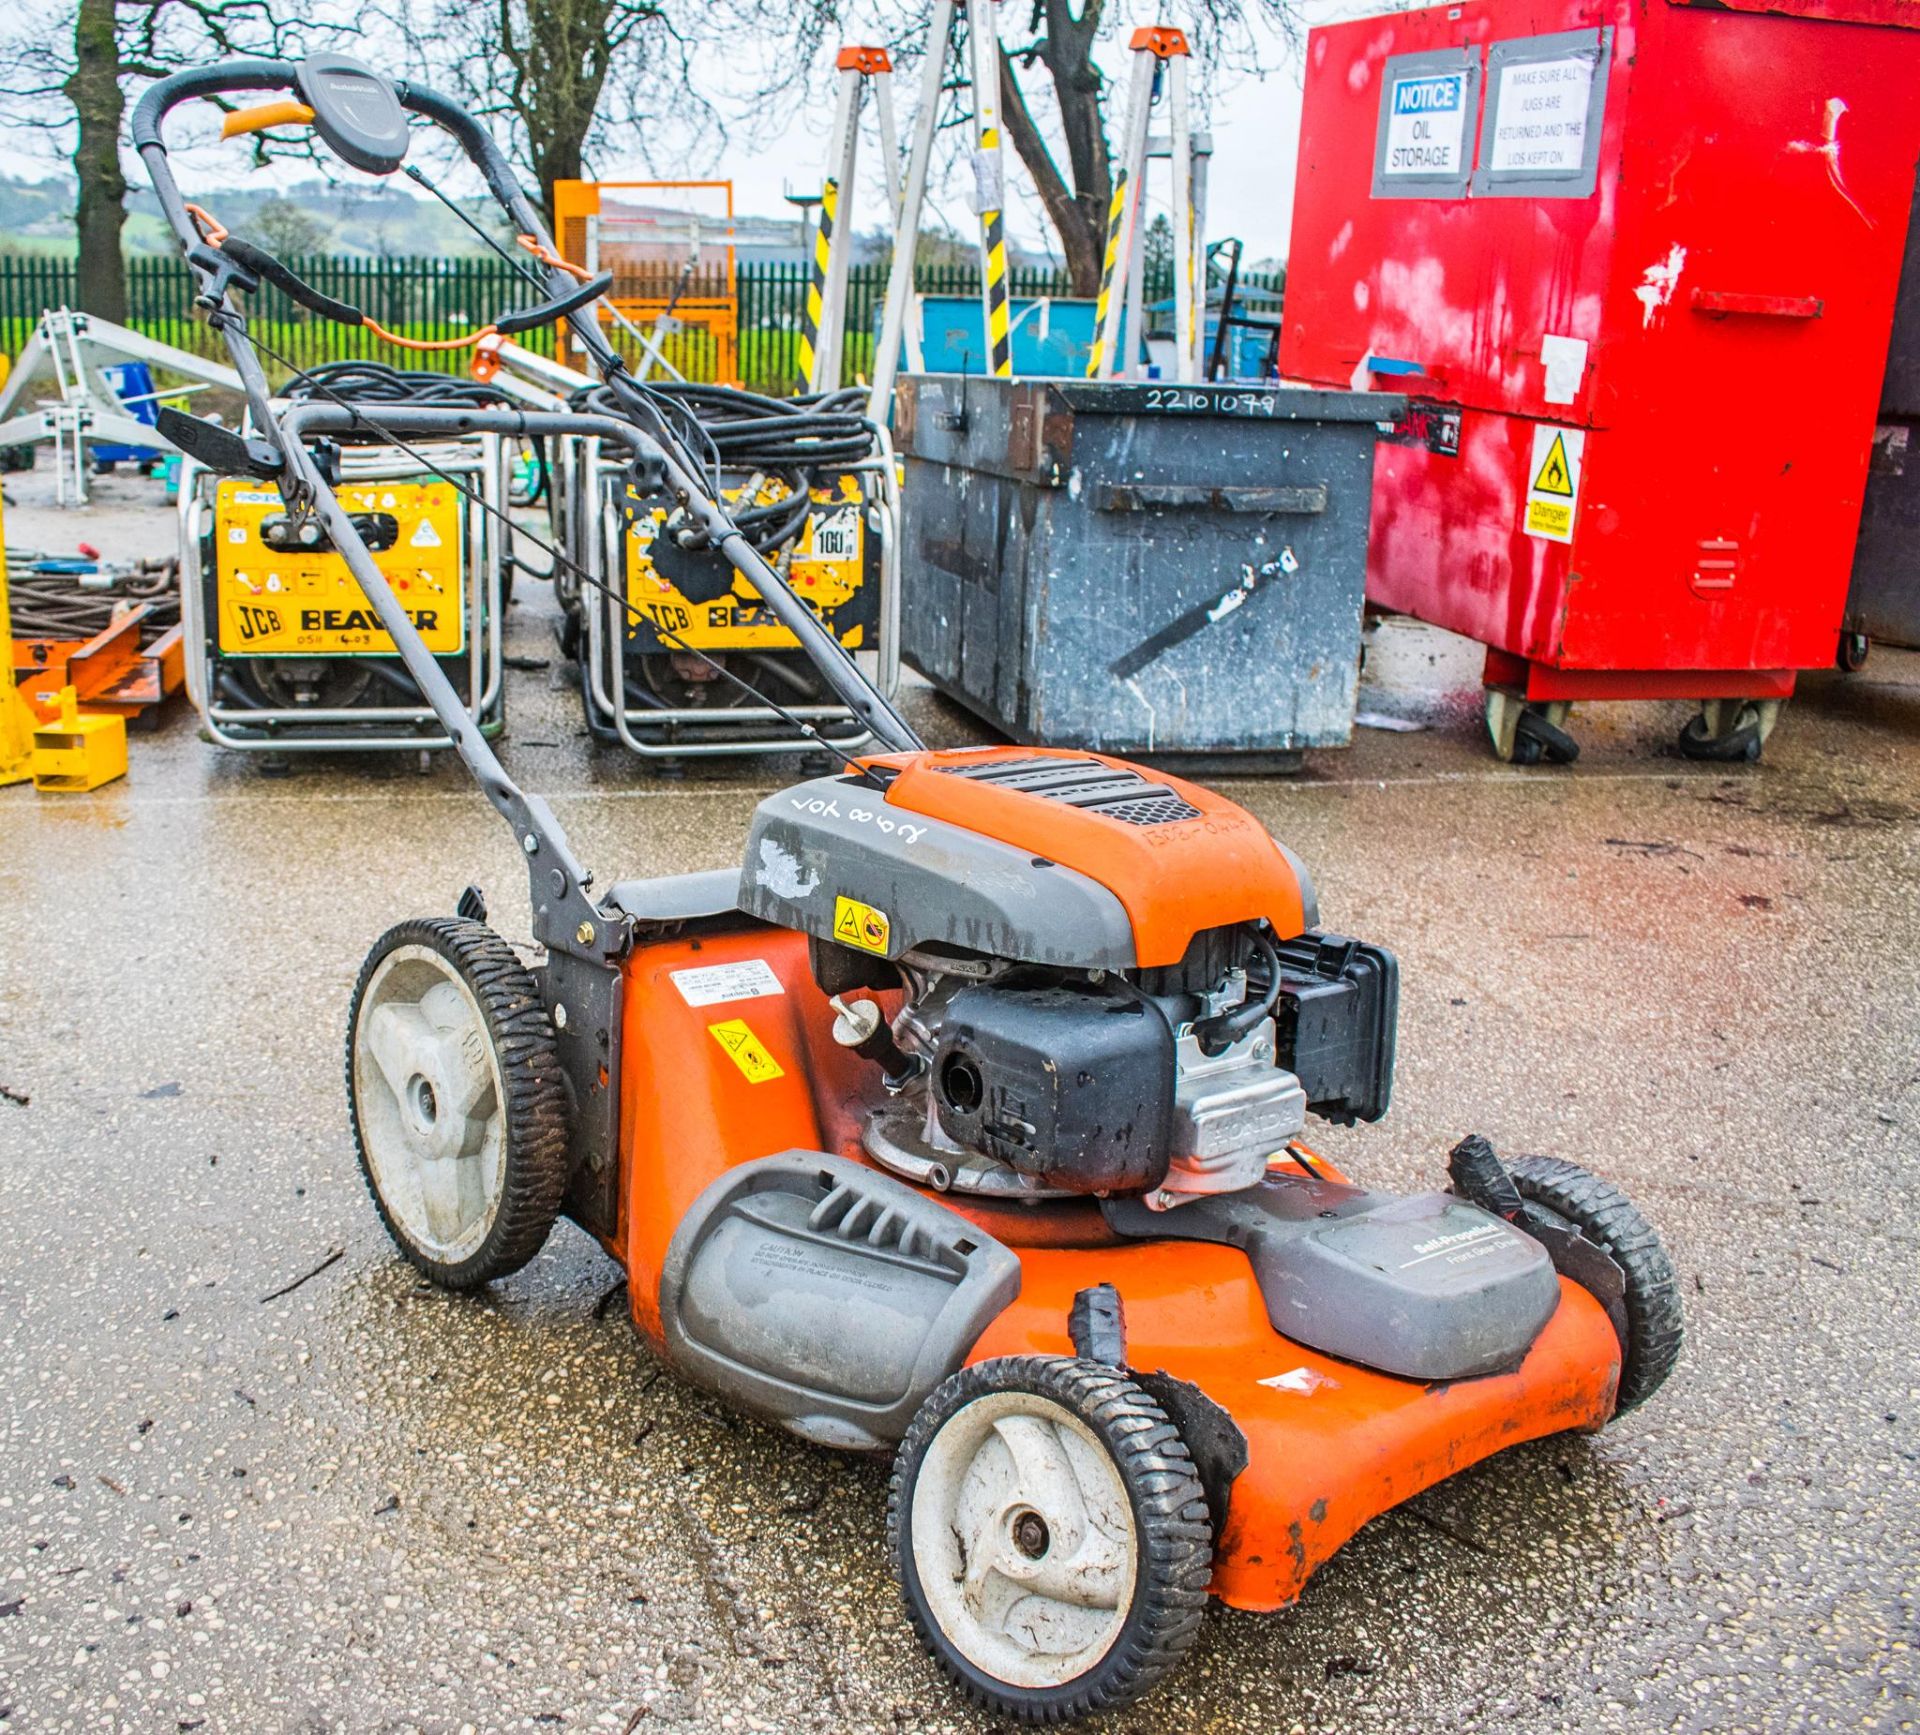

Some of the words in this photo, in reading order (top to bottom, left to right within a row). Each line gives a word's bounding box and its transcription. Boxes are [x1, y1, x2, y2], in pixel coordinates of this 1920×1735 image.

[1512, 71, 1538, 85] MAKE
[1539, 68, 1561, 84] SURE
[1562, 67, 1578, 80] ALL
[1399, 82, 1455, 109] NOTICE
[1521, 97, 1543, 112] JUGS
[1545, 95, 1562, 109] ARE
[1412, 120, 1432, 139] OIL
[1498, 125, 1542, 140] RETURNED
[1543, 123, 1563, 136] AND
[1565, 121, 1582, 135] THE
[1391, 147, 1451, 168] STORAGE
[1508, 151, 1526, 165] LIDS
[1528, 151, 1549, 164] KEPT
[1550, 150, 1564, 163] ON
[1533, 502, 1568, 523] Danger
[239, 605, 282, 640] JCB
[1207, 1101, 1300, 1149] HONDA
[1412, 1222, 1499, 1255] Self-Propelled
[759, 1242, 805, 1257] CAUTION
[806, 1268, 829, 1278] PLACE
